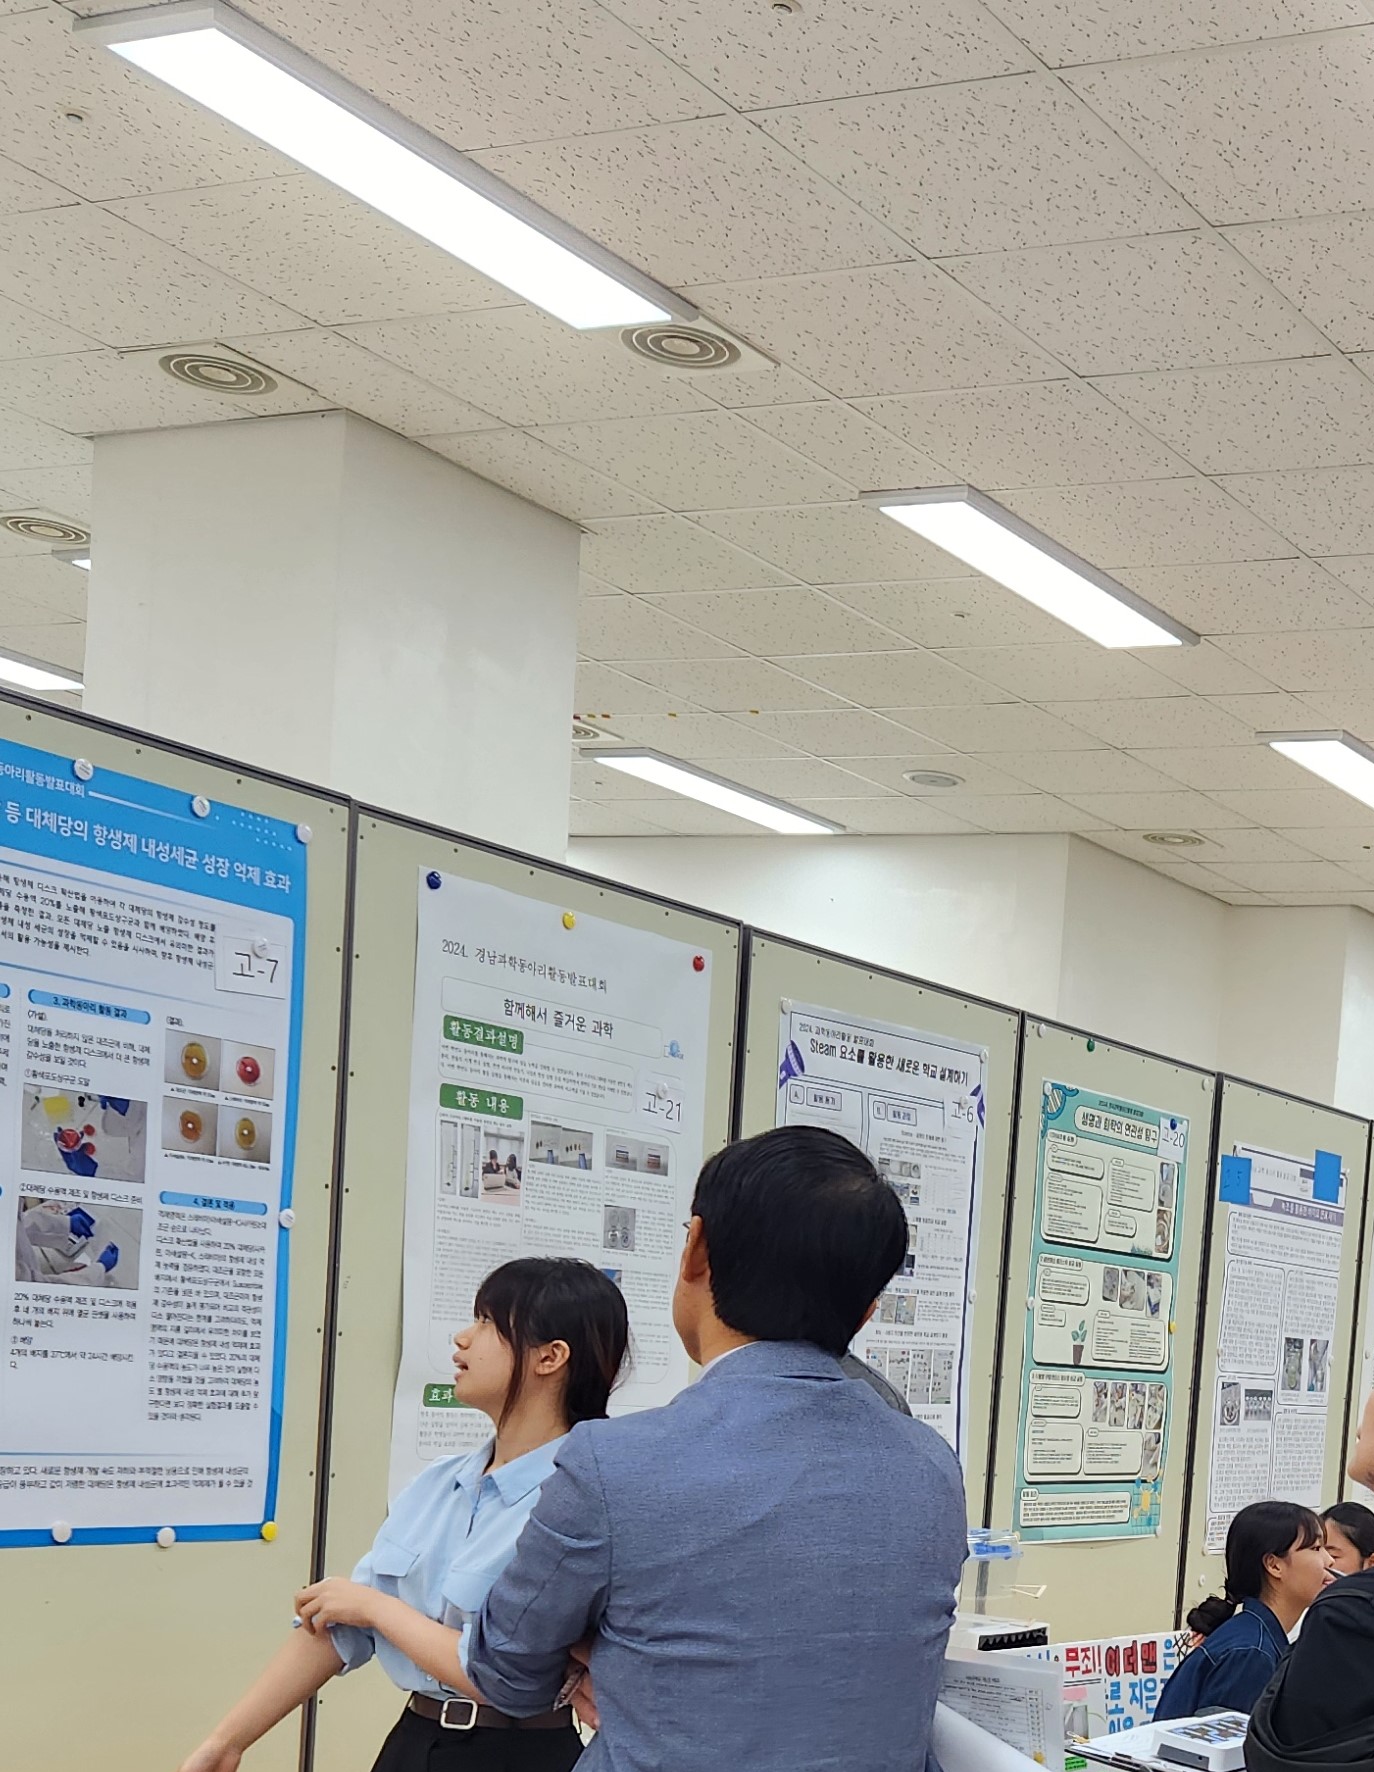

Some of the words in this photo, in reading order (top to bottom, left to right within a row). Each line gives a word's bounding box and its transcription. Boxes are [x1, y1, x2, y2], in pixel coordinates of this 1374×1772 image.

[6, 803, 21, 823] 등
[26, 805, 88, 841] 대체당의
[93, 823, 138, 854] 항생제
[142, 837, 199, 870] 내성세균
[202, 854, 230, 878] 성장
[234, 862, 260, 885] 억제
[264, 870, 292, 892] 효과
[233, 952, 278, 984] 고-7
[449, 1020, 519, 1050] 활동결과설명
[504, 998, 548, 1025] 함께해서
[553, 1010, 586, 1033] 즐거운
[592, 1020, 614, 1039] 과학
[810, 1038, 837, 1058] Steam
[840, 1045, 865, 1064] 요소를
[868, 1052, 894, 1070] 활용한
[896, 1058, 920, 1076] 새로운
[922, 1064, 938, 1079] 학교
[940, 1067, 968, 1088] 설계하기
[454, 1090, 480, 1110] 활동
[485, 1096, 510, 1114] 내용
[643, 1091, 682, 1123] 고-21
[1145, 1128, 1158, 1144] 탐구
[1064, 1644, 1102, 1678] 무죄!
[1108, 1680, 1125, 1716] 로
